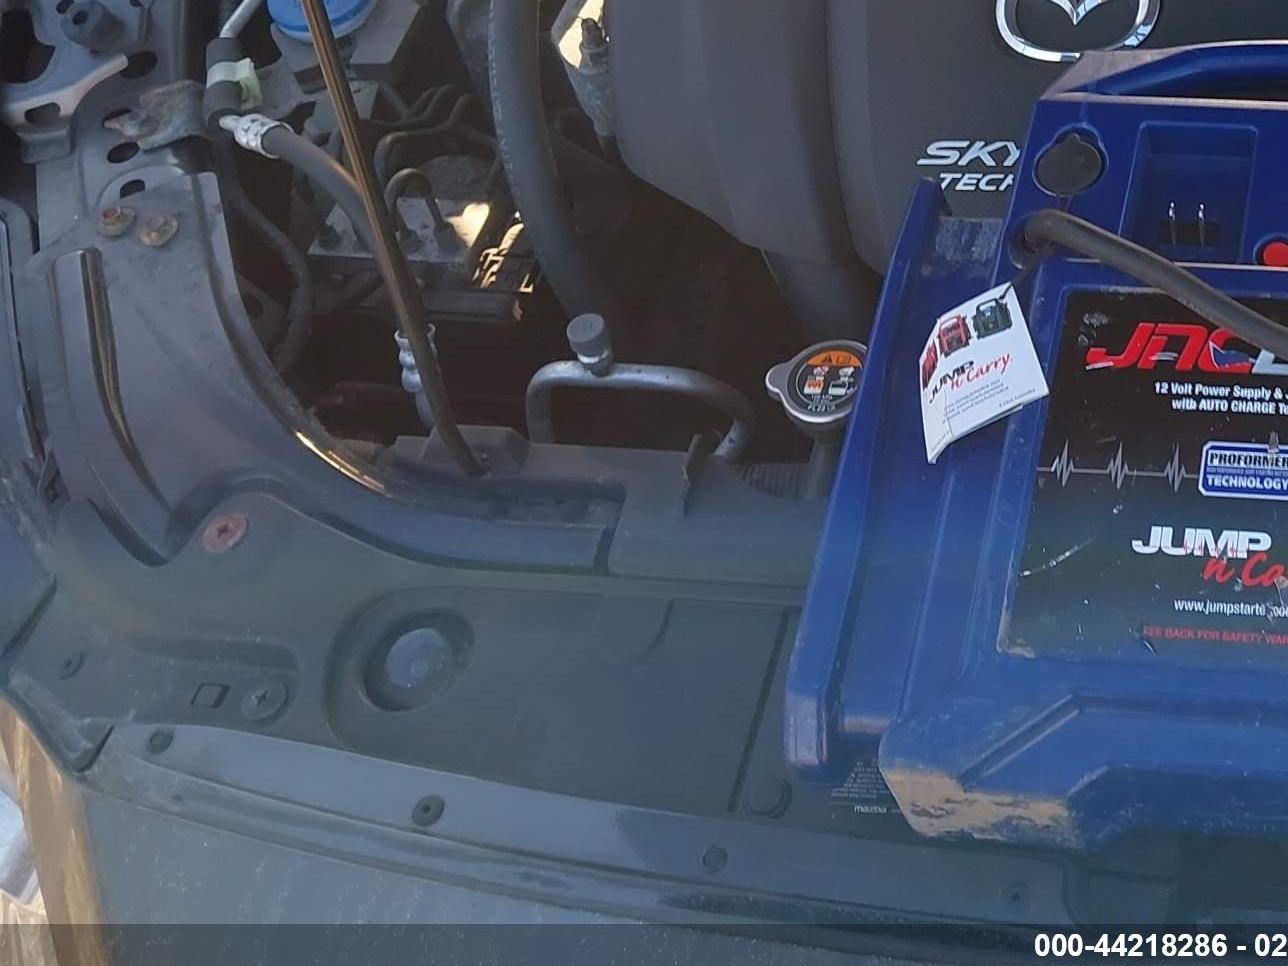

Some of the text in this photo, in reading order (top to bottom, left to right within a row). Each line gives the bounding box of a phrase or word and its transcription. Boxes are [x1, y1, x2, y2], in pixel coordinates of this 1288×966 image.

[1154, 381, 1169, 394] 12
[1171, 382, 1192, 395] Volt
[1194, 383, 1231, 397] Power
[1232, 385, 1272, 401] Supply
[1273, 387, 1284, 400] &
[1171, 397, 1197, 410] with
[1198, 399, 1229, 412] AUTO
[1230, 401, 1276, 415] CHARGE
[1131, 525, 1272, 559] JUMP
[1165, 627, 1195, 638] BACK
[1196, 629, 1220, 641] FOR
[1221, 630, 1264, 643] SAFETY
